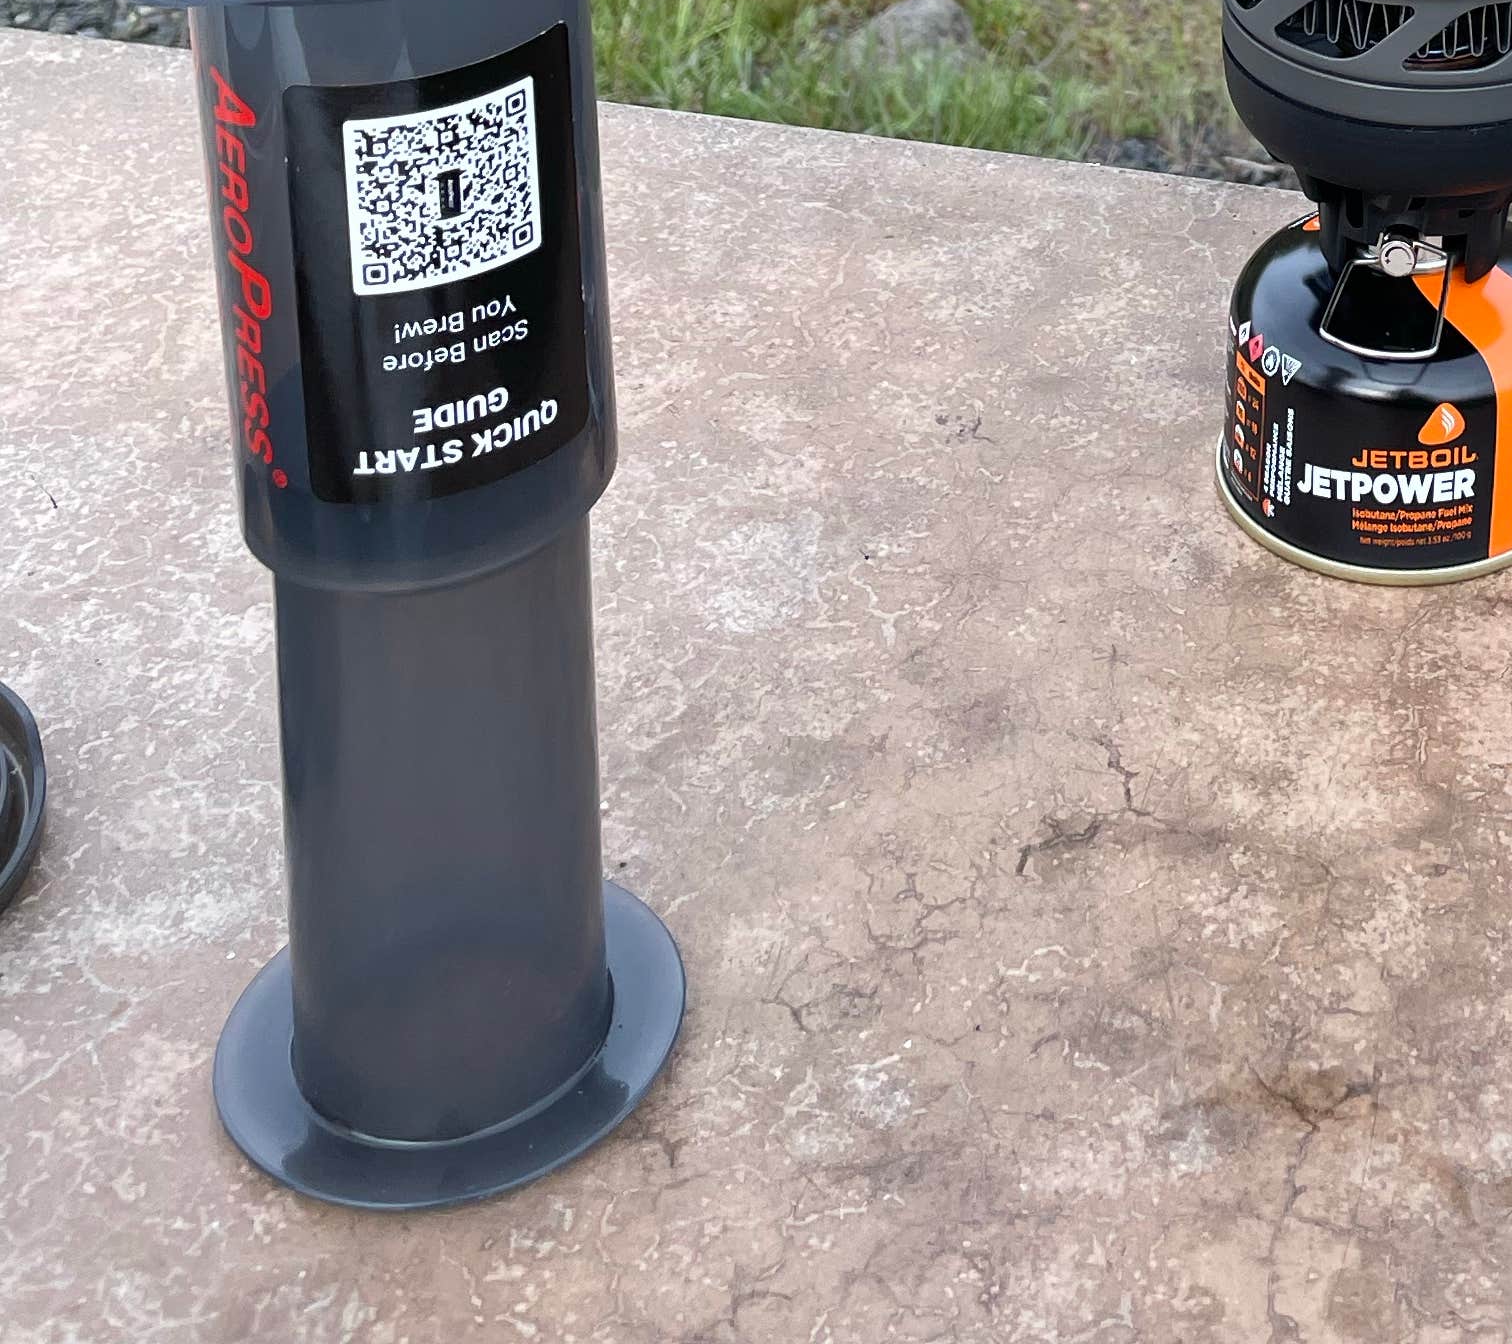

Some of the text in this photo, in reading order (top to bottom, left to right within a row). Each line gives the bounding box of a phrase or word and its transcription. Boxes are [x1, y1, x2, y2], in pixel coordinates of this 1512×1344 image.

[394, 294, 517, 344] You Brew!
[383, 319, 529, 371] Scan Before
[412, 386, 509, 434] GUIDE
[353, 399, 558, 475] QUICK START
[1352, 445, 1478, 469] JETBOIL
[1297, 463, 1476, 504] JETPOWER
[1352, 519, 1388, 534] Mélange
[1438, 506, 1457, 518] Fuel
[1458, 504, 1473, 514] Mix
